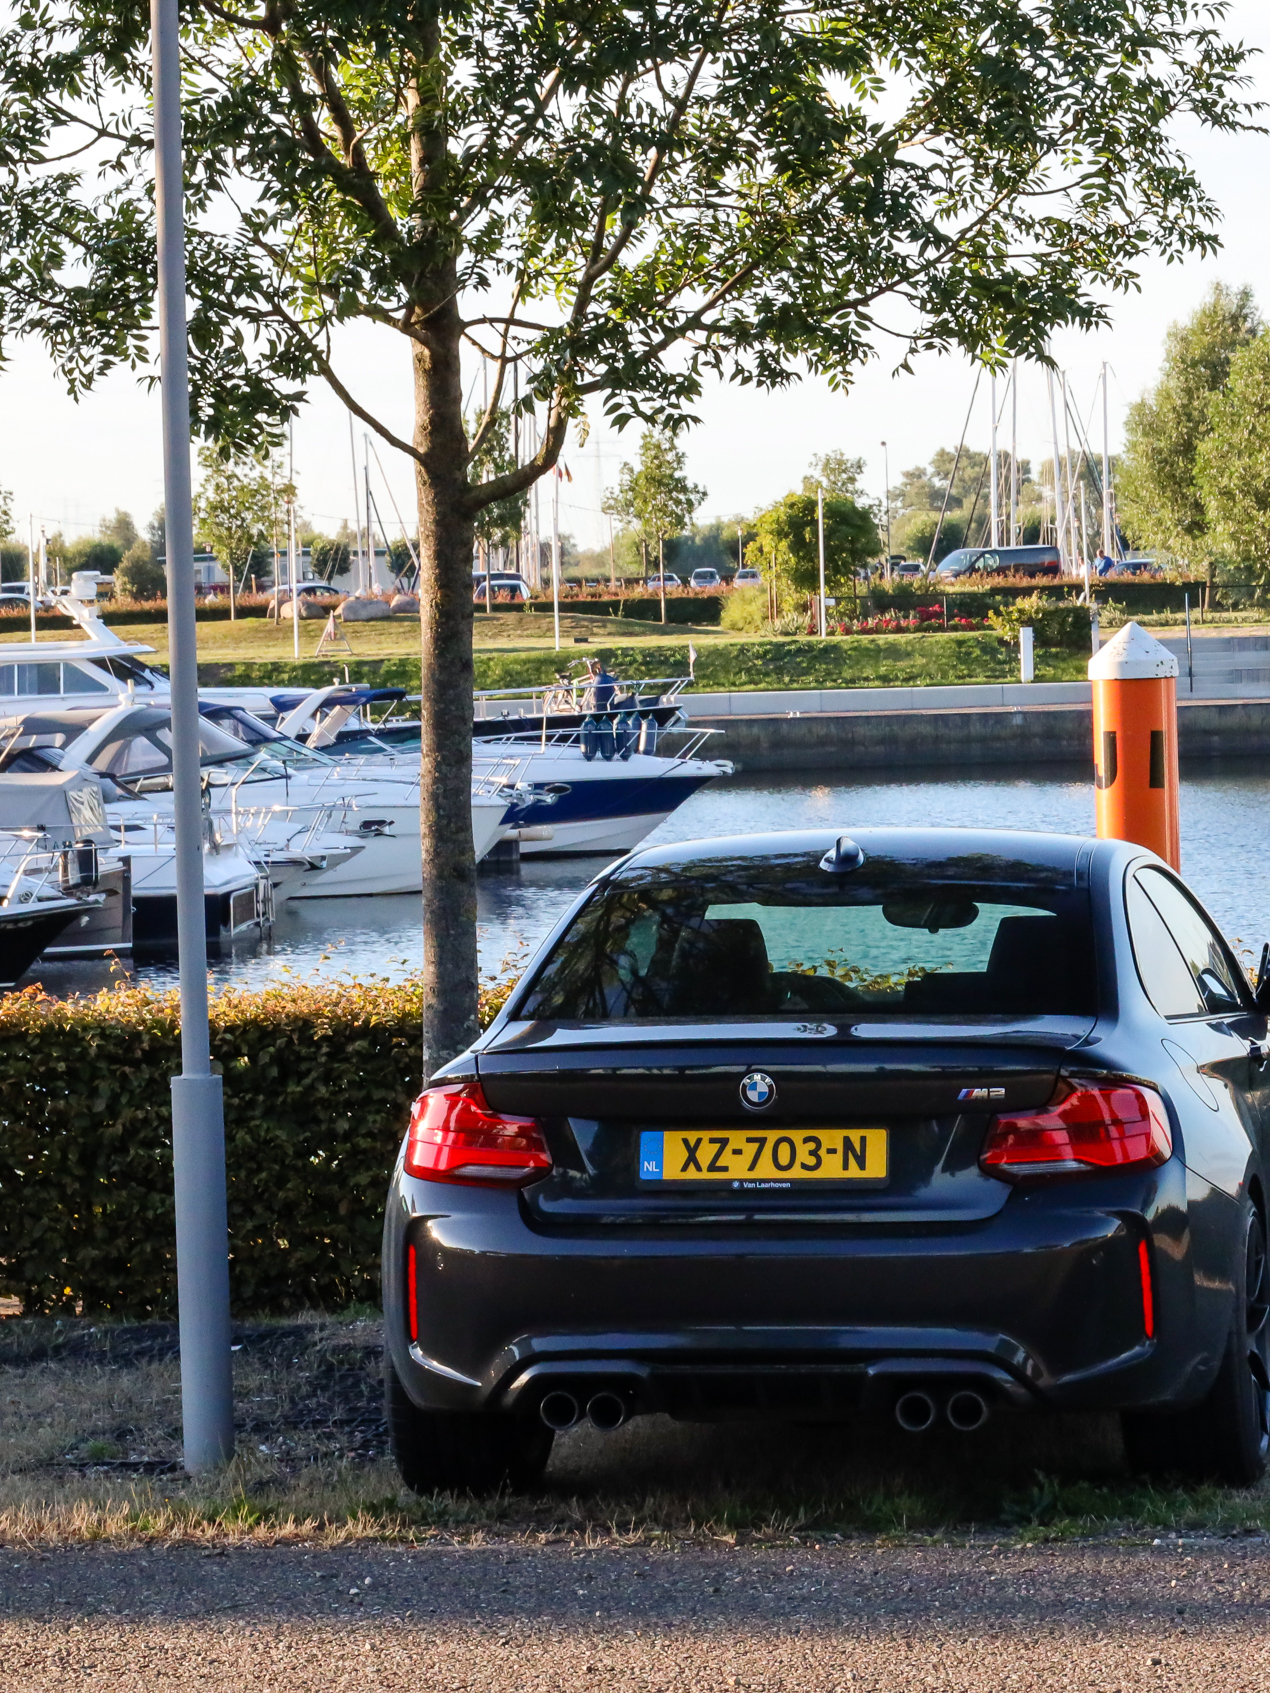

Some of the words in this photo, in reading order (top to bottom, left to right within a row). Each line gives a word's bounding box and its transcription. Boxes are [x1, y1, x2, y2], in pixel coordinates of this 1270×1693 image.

[969, 1088, 1006, 1099] M2
[680, 1135, 867, 1173] XZ-703-N
[643, 1161, 660, 1172] NL
[743, 1181, 756, 1189] Van
[757, 1181, 791, 1189] Laarhoven
